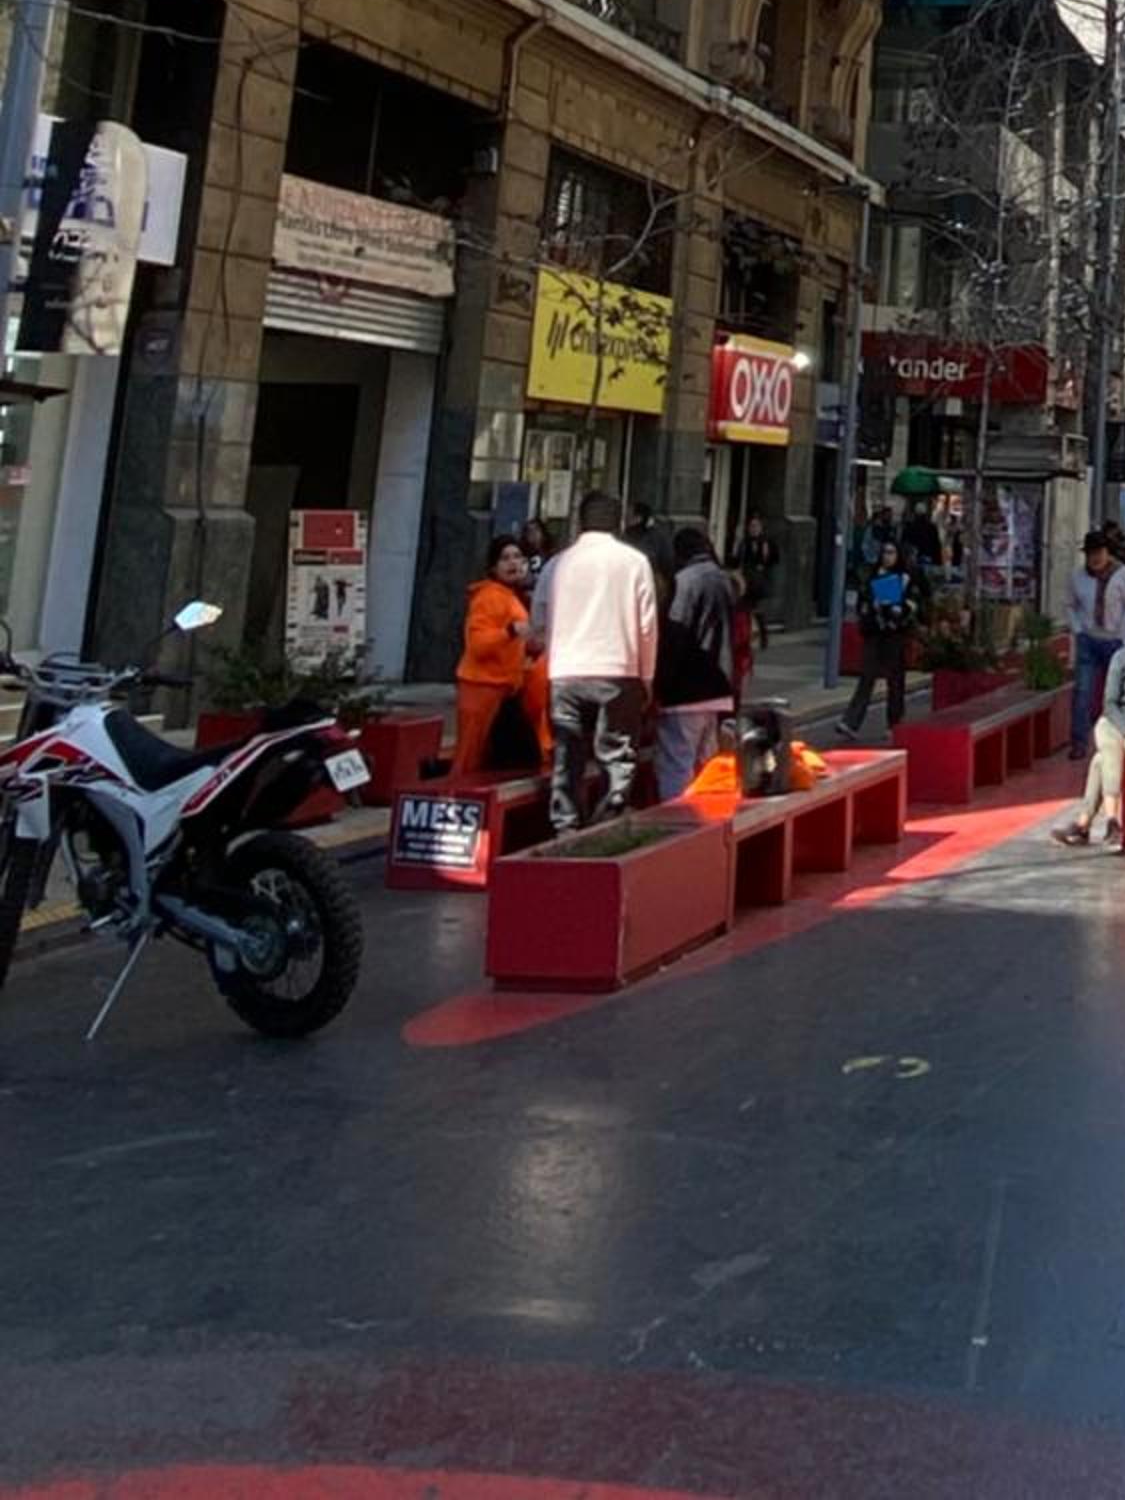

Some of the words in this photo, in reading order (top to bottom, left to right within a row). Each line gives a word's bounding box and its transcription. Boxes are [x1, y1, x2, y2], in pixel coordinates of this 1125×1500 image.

[858, 355, 969, 381] ander
[731, 358, 791, 423] OXXO
[402, 800, 479, 833] MESS
